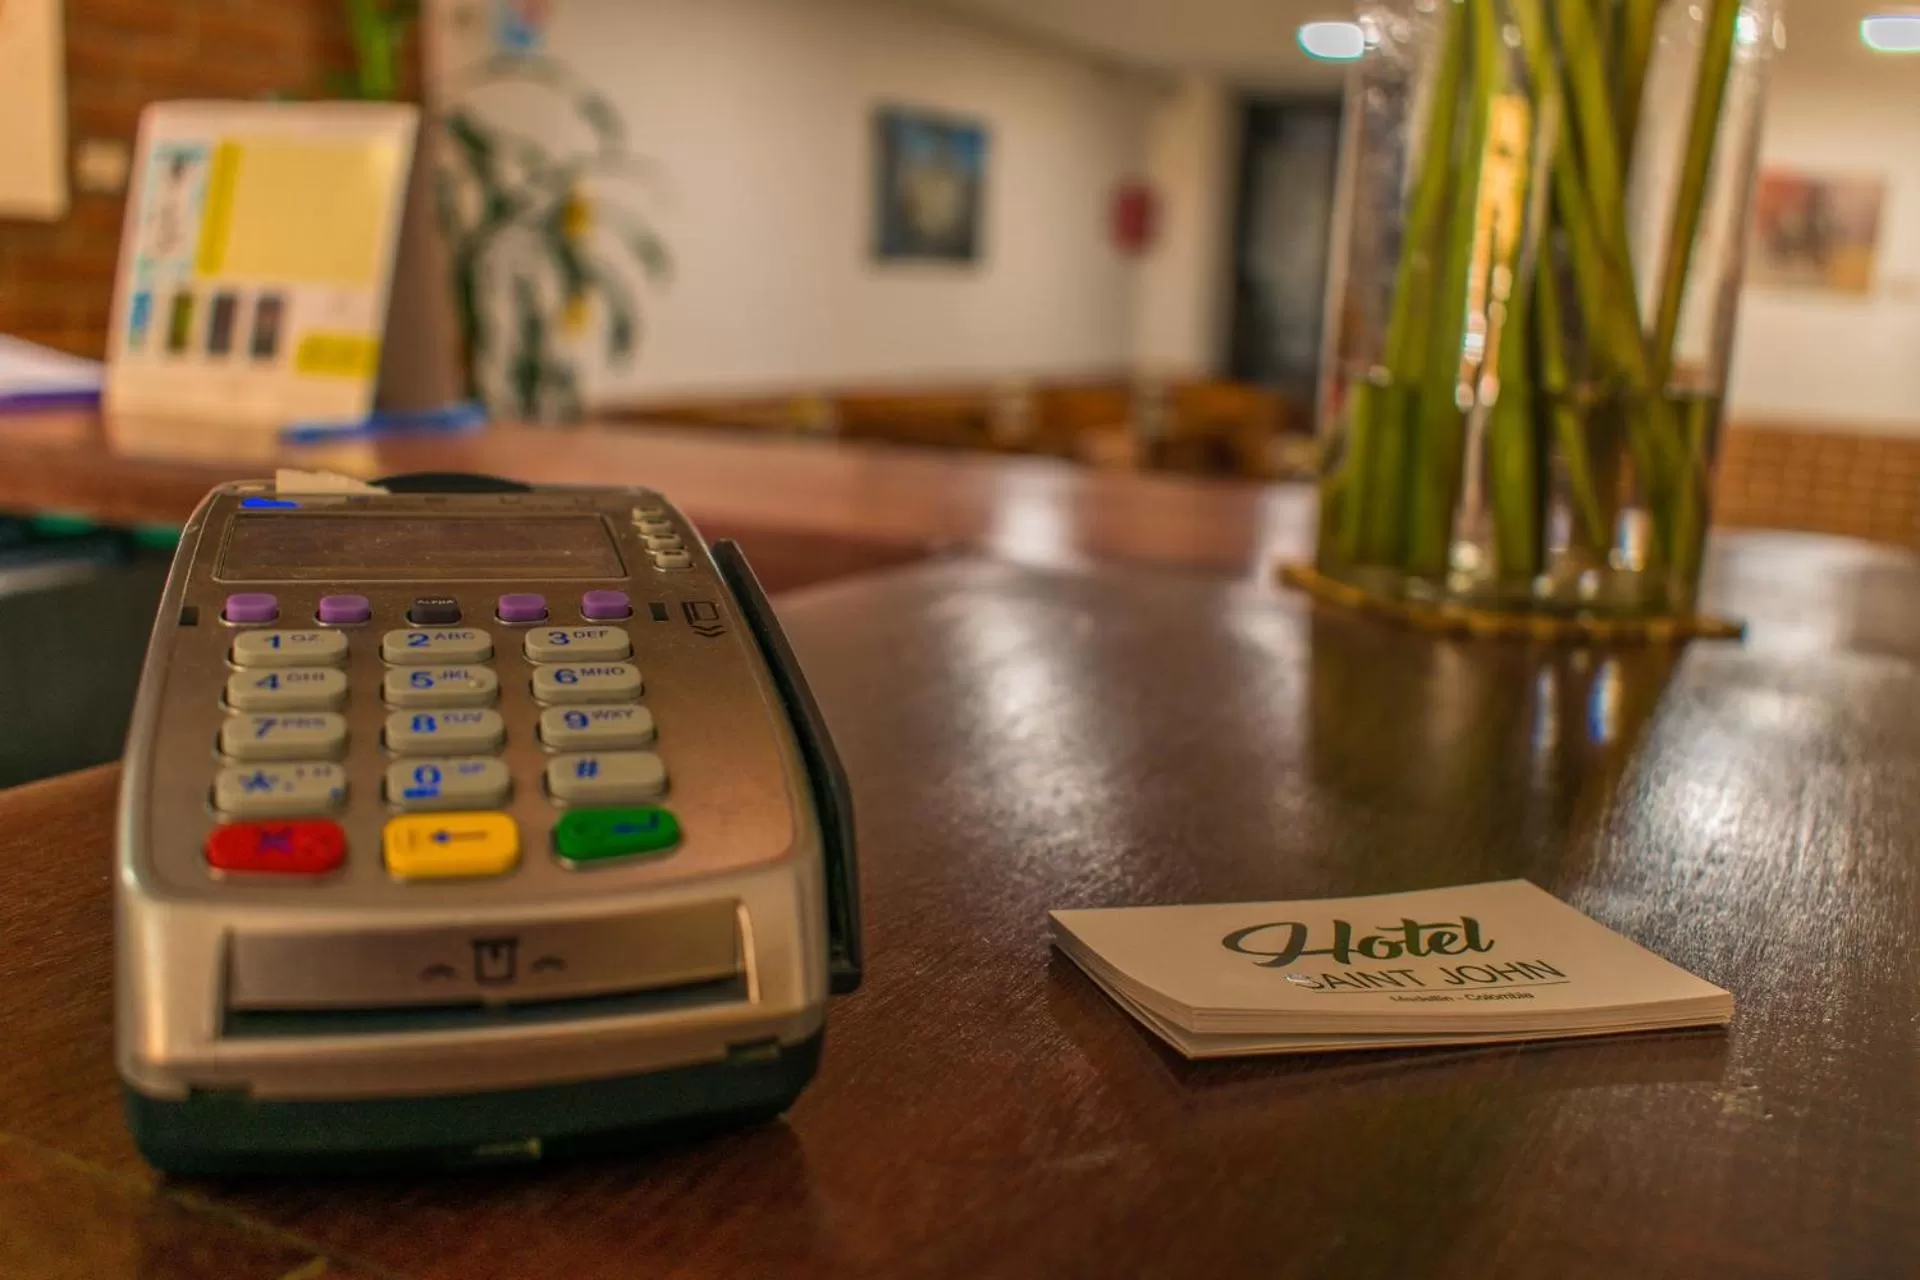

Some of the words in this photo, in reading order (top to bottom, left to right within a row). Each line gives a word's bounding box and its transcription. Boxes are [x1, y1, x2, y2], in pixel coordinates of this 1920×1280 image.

[263, 634, 281, 649] 1
[407, 632, 431, 648] 2
[434, 631, 475, 641] ABC
[548, 631, 571, 646] 3
[573, 630, 609, 640] DEF
[254, 673, 280, 691] 4
[411, 671, 435, 689] 5
[554, 668, 579, 685] 6
[581, 667, 626, 677] MNO
[251, 717, 279, 738] 7
[411, 713, 437, 733] 8
[563, 711, 590, 730] 9
[592, 710, 635, 720] WXY
[576, 760, 598, 778] #
[1222, 916, 1495, 967] Hotel
[1285, 969, 1426, 990] SAINT
[1444, 960, 1567, 986] JOHN
